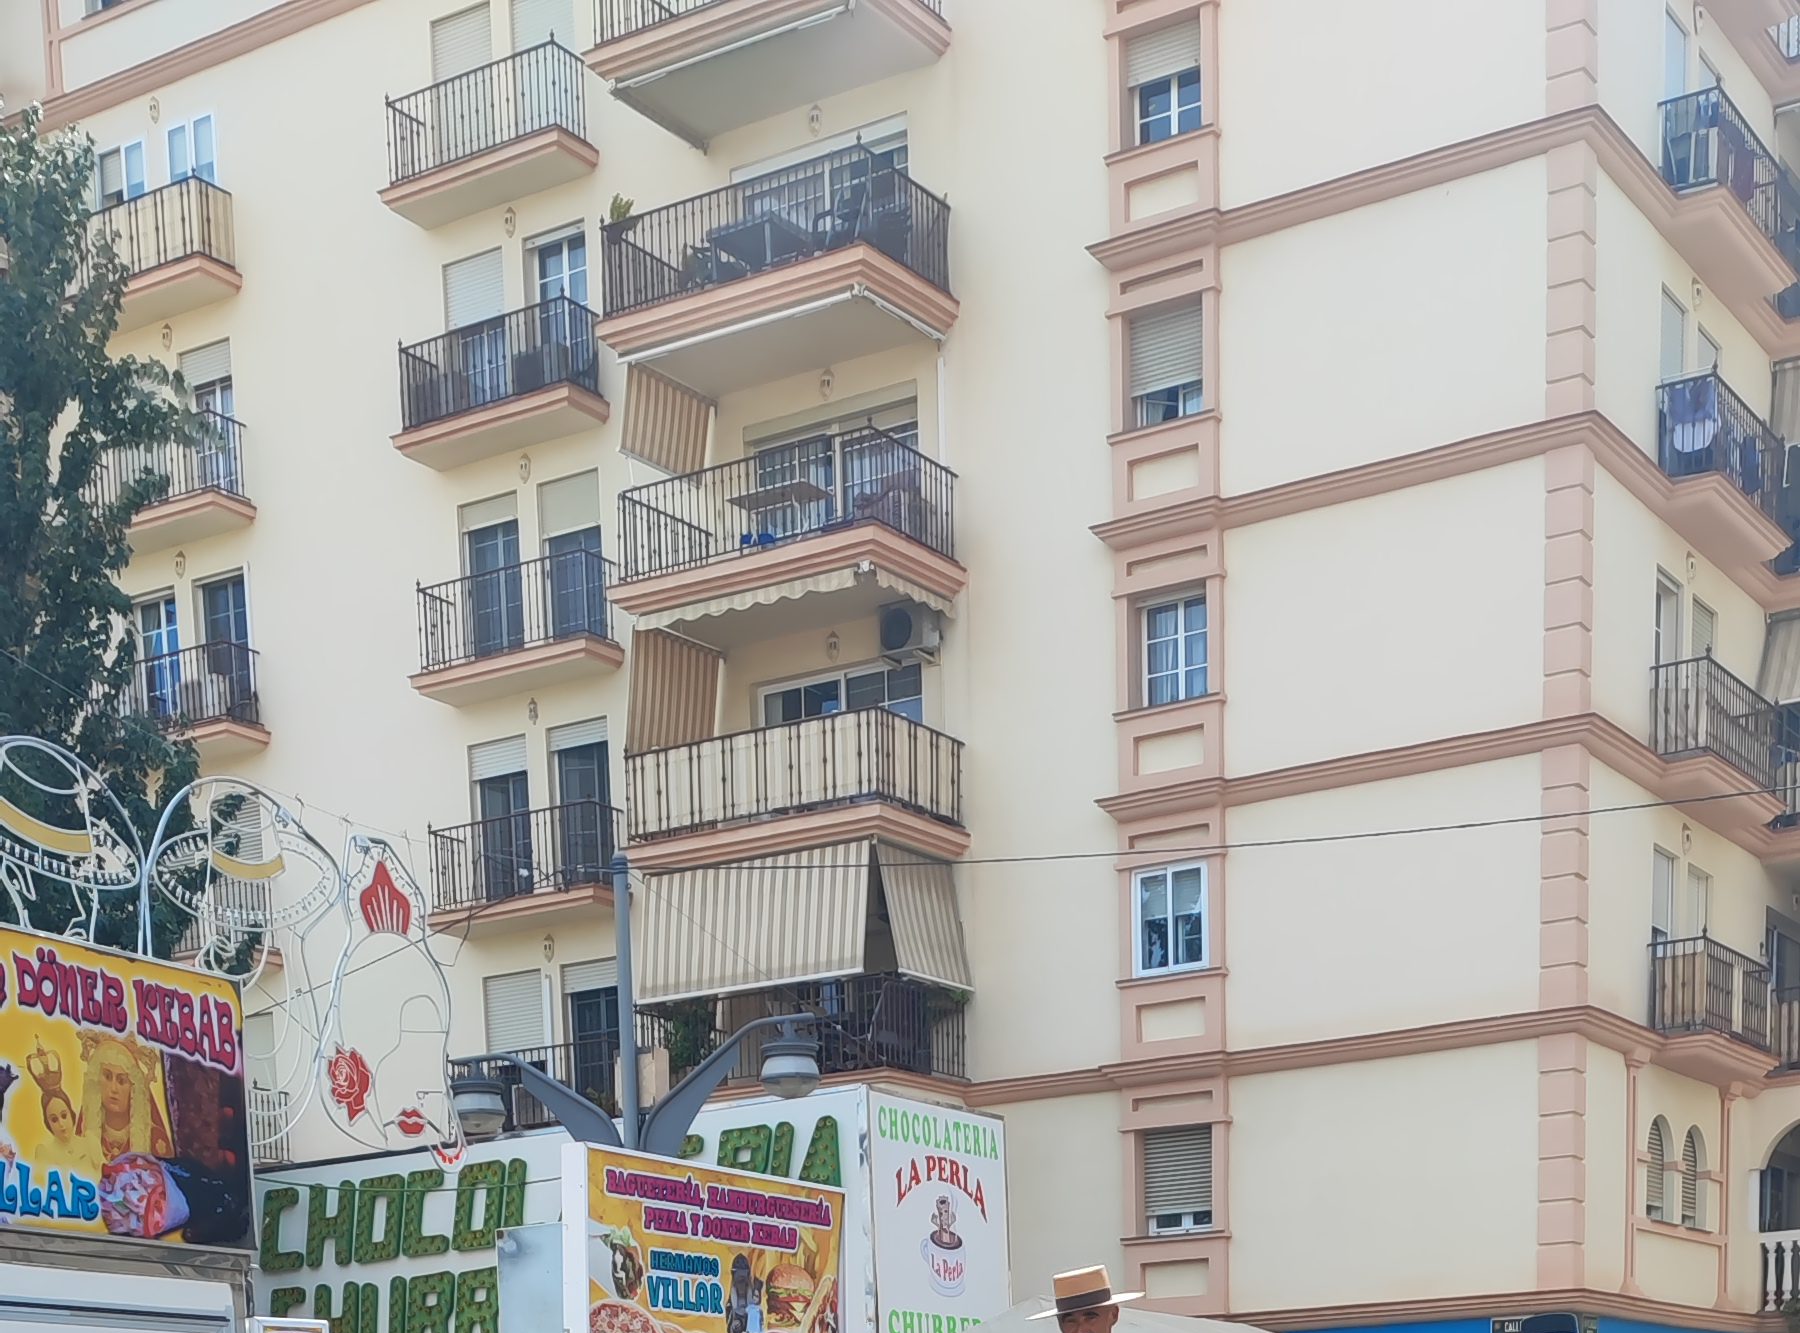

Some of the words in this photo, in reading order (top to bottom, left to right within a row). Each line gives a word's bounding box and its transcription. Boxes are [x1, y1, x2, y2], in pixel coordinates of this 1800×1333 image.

[13, 947, 128, 1033] DÖNER
[133, 978, 237, 1072] KEBAB
[877, 1105, 999, 1161] CHOCOLATERIA
[895, 1157, 922, 1208] LA
[924, 1154, 989, 1224] PERLA
[644, 1206, 688, 1235] PIZZA
[690, 1213, 702, 1237] Y
[752, 1222, 799, 1250] KEBAB
[650, 1249, 720, 1277] HERMANOS
[930, 1253, 942, 1275] La
[942, 1258, 964, 1282] Perla
[646, 1275, 724, 1315] VILLAR
